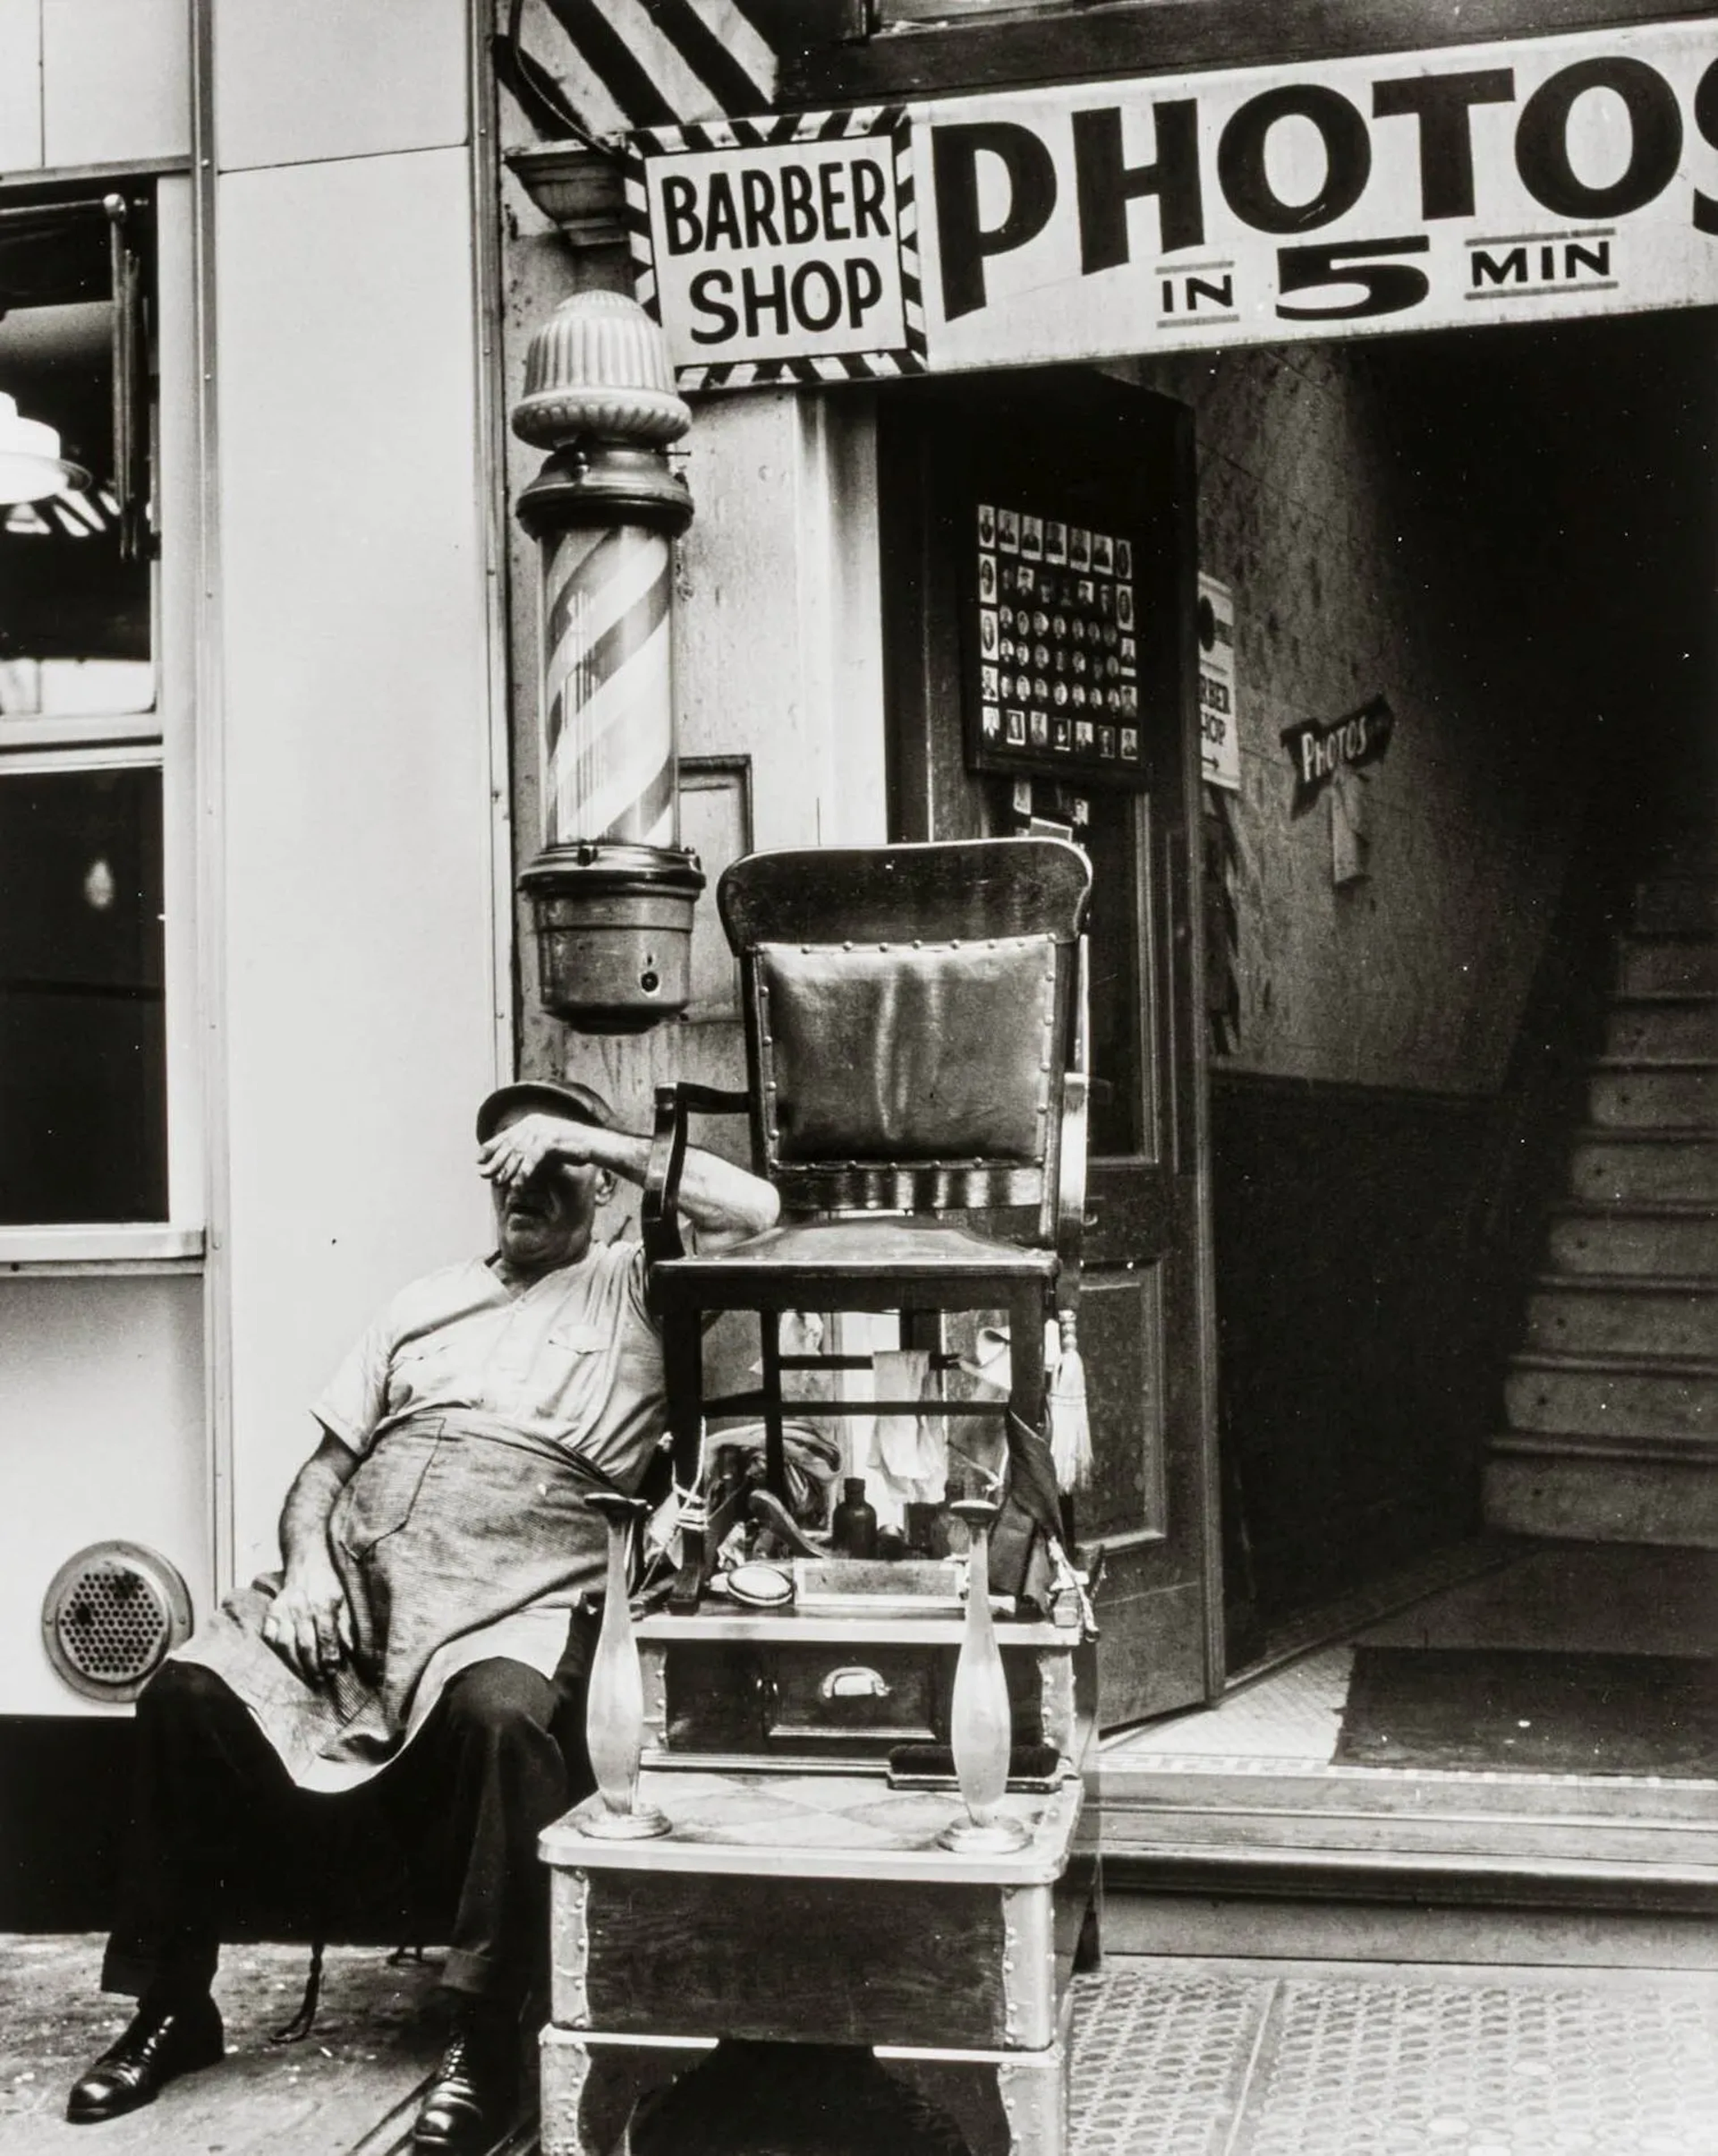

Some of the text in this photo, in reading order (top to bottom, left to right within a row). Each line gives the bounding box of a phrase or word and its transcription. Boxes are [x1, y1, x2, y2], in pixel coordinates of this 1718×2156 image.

[662, 159, 891, 256] BARBER
[931, 56, 1718, 322] PHOTO
[689, 258, 882, 345] SHOP
[1162, 235, 1610, 321] IN 5 MIN
[1301, 716, 1367, 782] PHOTOS
